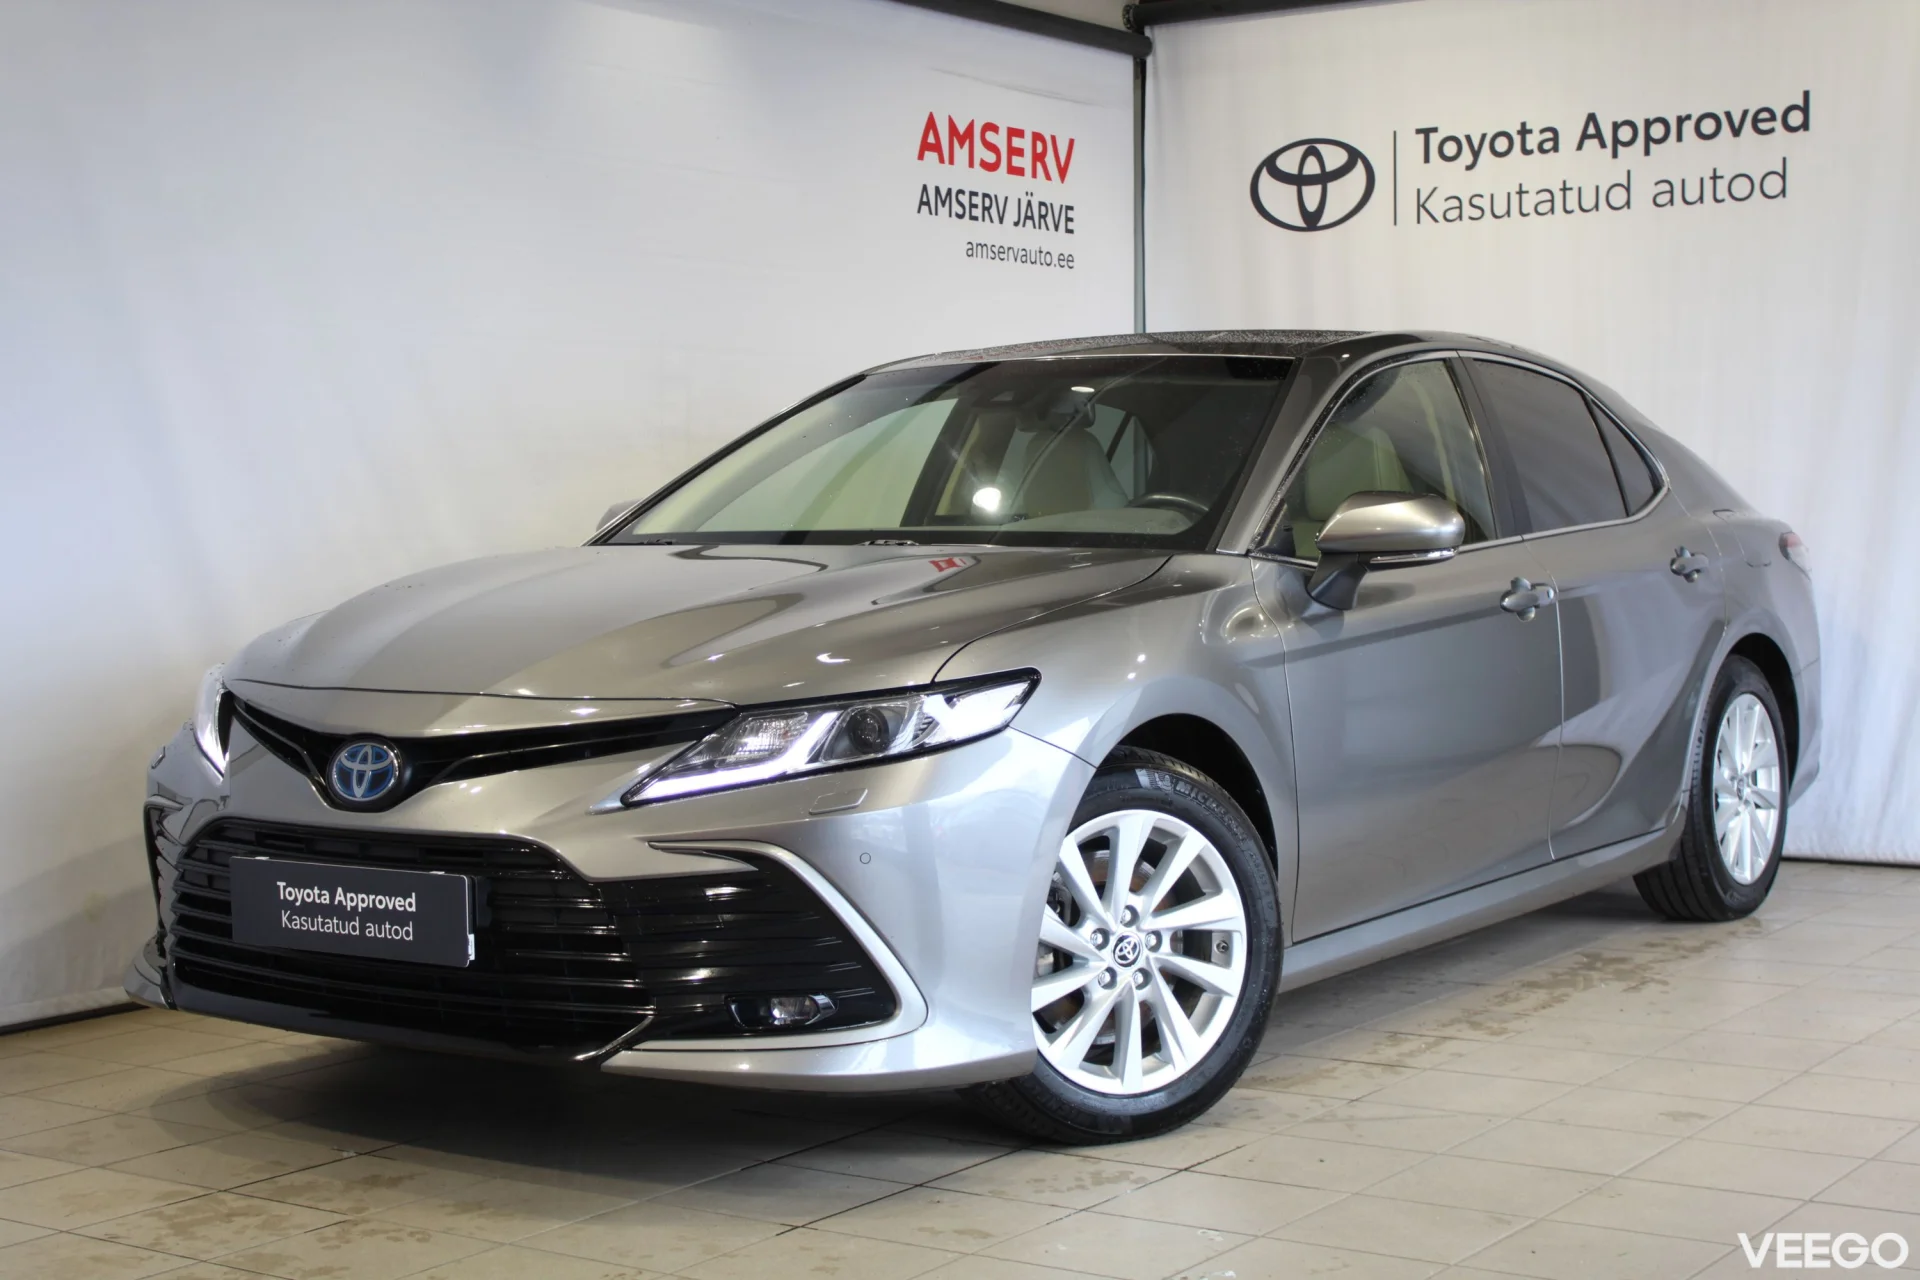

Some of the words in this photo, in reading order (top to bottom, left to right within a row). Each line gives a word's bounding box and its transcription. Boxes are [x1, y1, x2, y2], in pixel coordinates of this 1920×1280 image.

[917, 111, 1075, 184] AMSERV
[1416, 121, 1560, 171] Toyota
[1576, 90, 1811, 158] Approved
[917, 183, 1008, 225] AMSERV
[1013, 191, 1075, 234] JÄRVE
[1416, 170, 1632, 225] Kasutatud
[1652, 157, 1788, 208] autod
[966, 241, 1075, 270] amservauto.ee
[1175, 780, 1249, 843] MICH
[277, 881, 330, 907] Toyota
[334, 887, 416, 912] Approved
[281, 910, 360, 935] Kasutatud
[366, 921, 413, 941] autod
